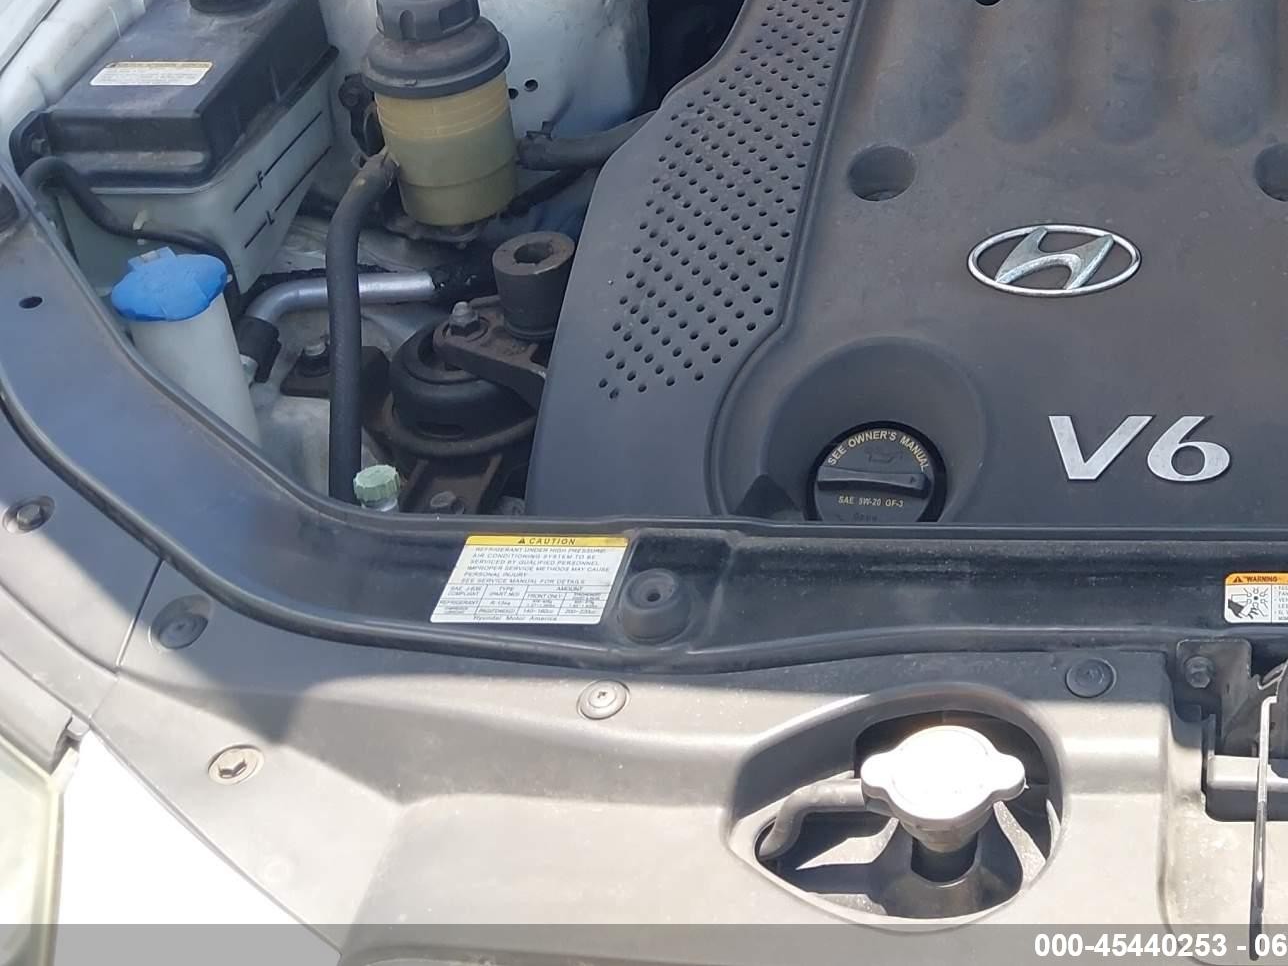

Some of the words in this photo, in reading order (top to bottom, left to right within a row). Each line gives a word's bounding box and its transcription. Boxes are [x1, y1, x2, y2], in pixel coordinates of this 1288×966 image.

[256, 170, 264, 188] F
[266, 210, 275, 225] L
[828, 446, 848, 466] SEE
[848, 430, 898, 448] OWNER'S
[899, 436, 929, 472] MANUAL
[1048, 415, 1231, 482] V6
